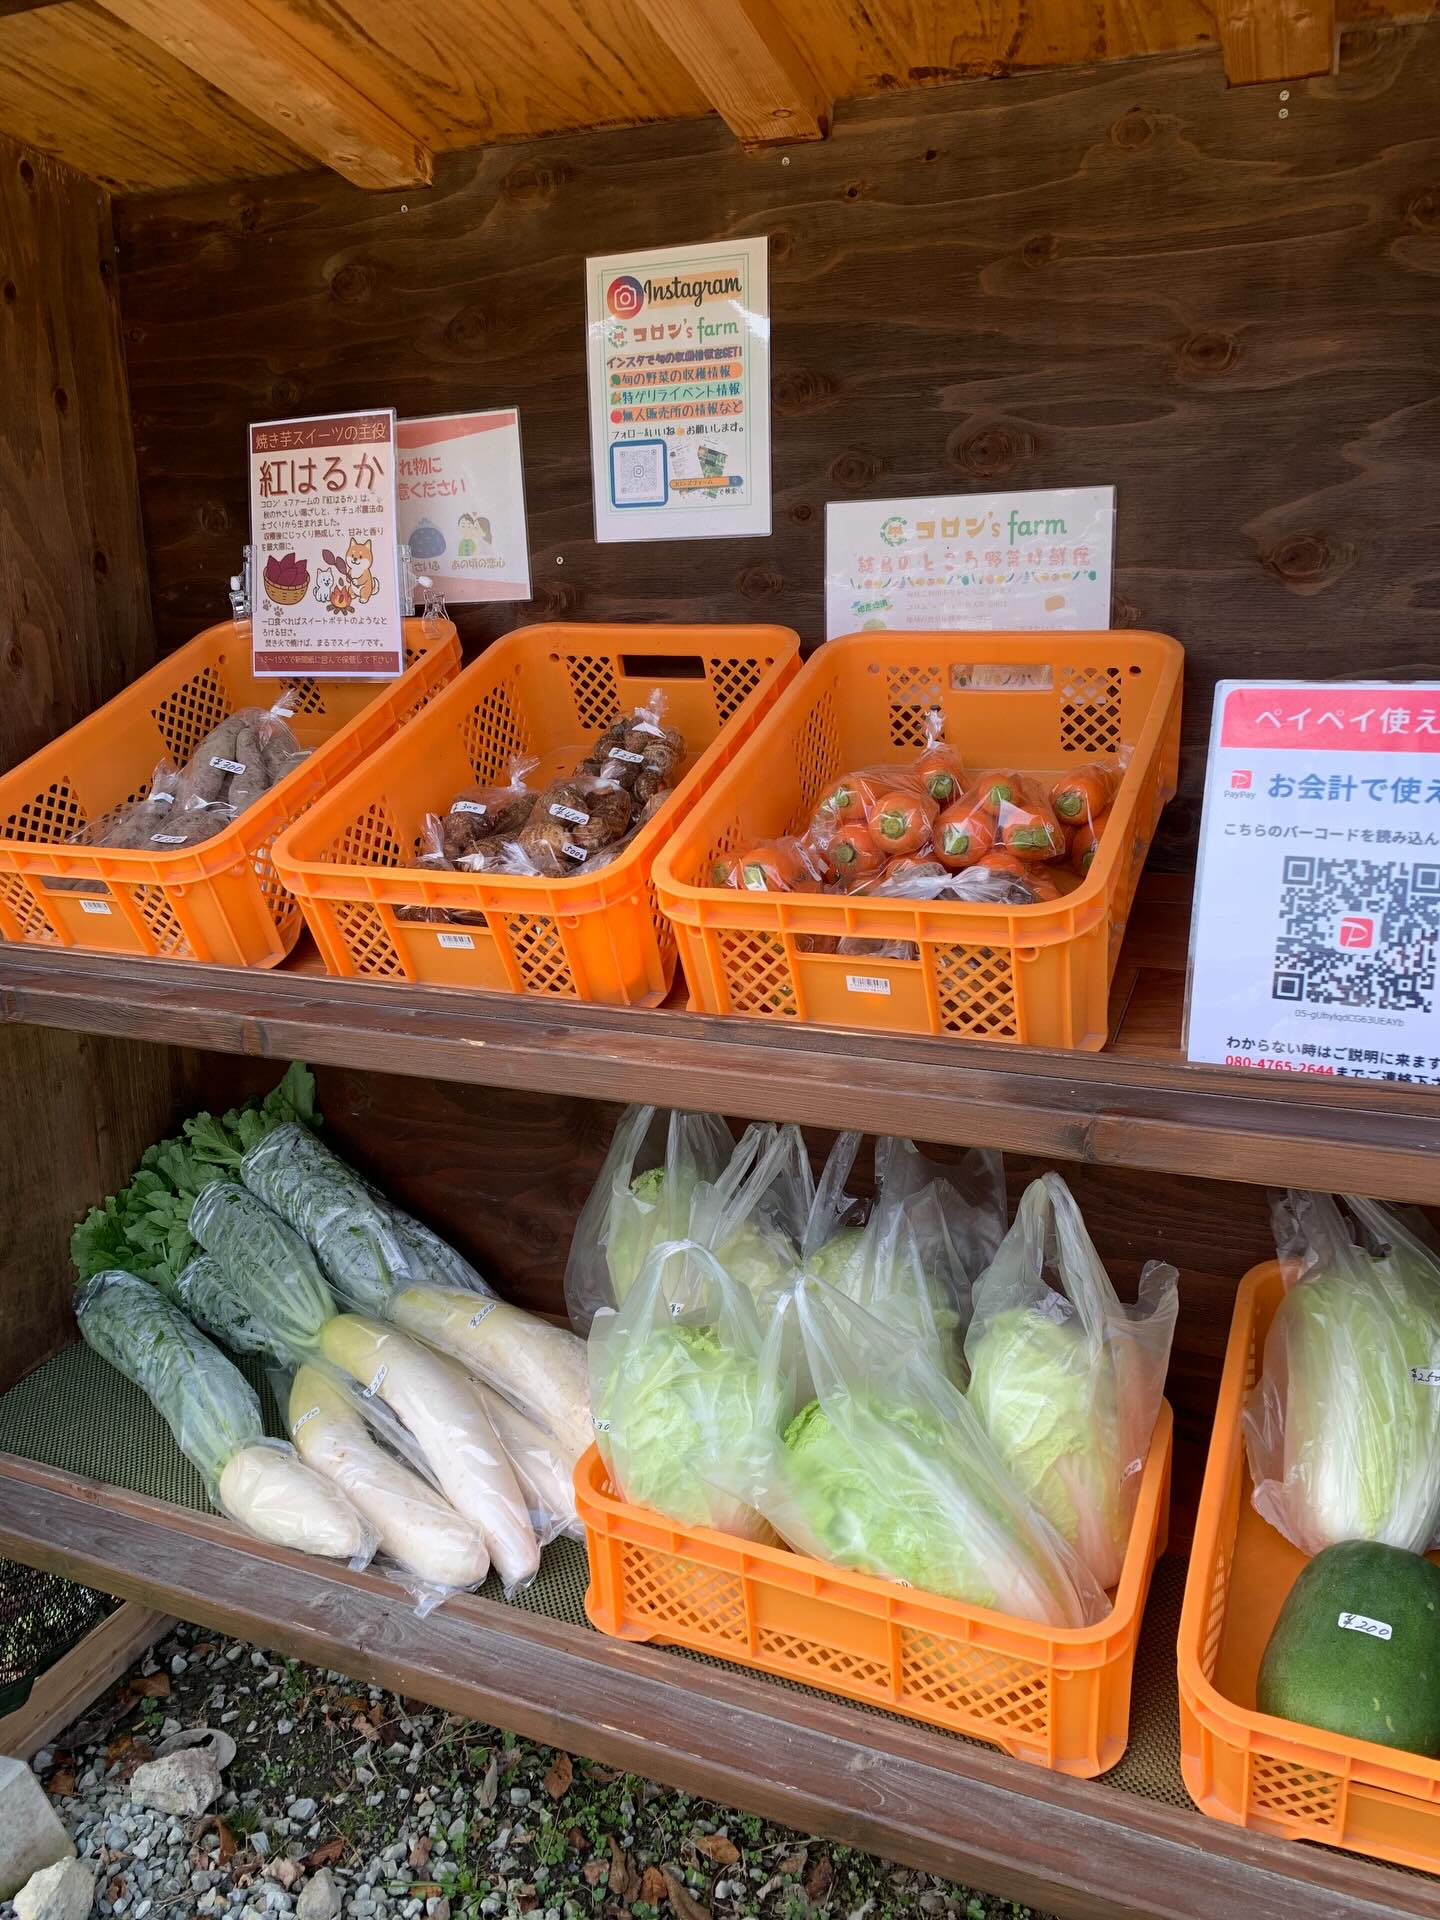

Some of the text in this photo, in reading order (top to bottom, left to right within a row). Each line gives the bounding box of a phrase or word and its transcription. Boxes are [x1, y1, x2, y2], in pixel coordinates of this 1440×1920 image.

[643, 276, 742, 307] Instagram
[697, 316, 739, 344] farm
[255, 423, 386, 449] 焼き芋スイーツの主役
[258, 452, 385, 498] 紅はるか
[1007, 510, 1067, 545] farm
[1255, 707, 1440, 734] ペイペイ使え
[1224, 790, 1256, 800] PayPay
[1224, 822, 1439, 846] こちらのバーコードを読み込ん
[1343, 1614, 1391, 1636] ¥200
